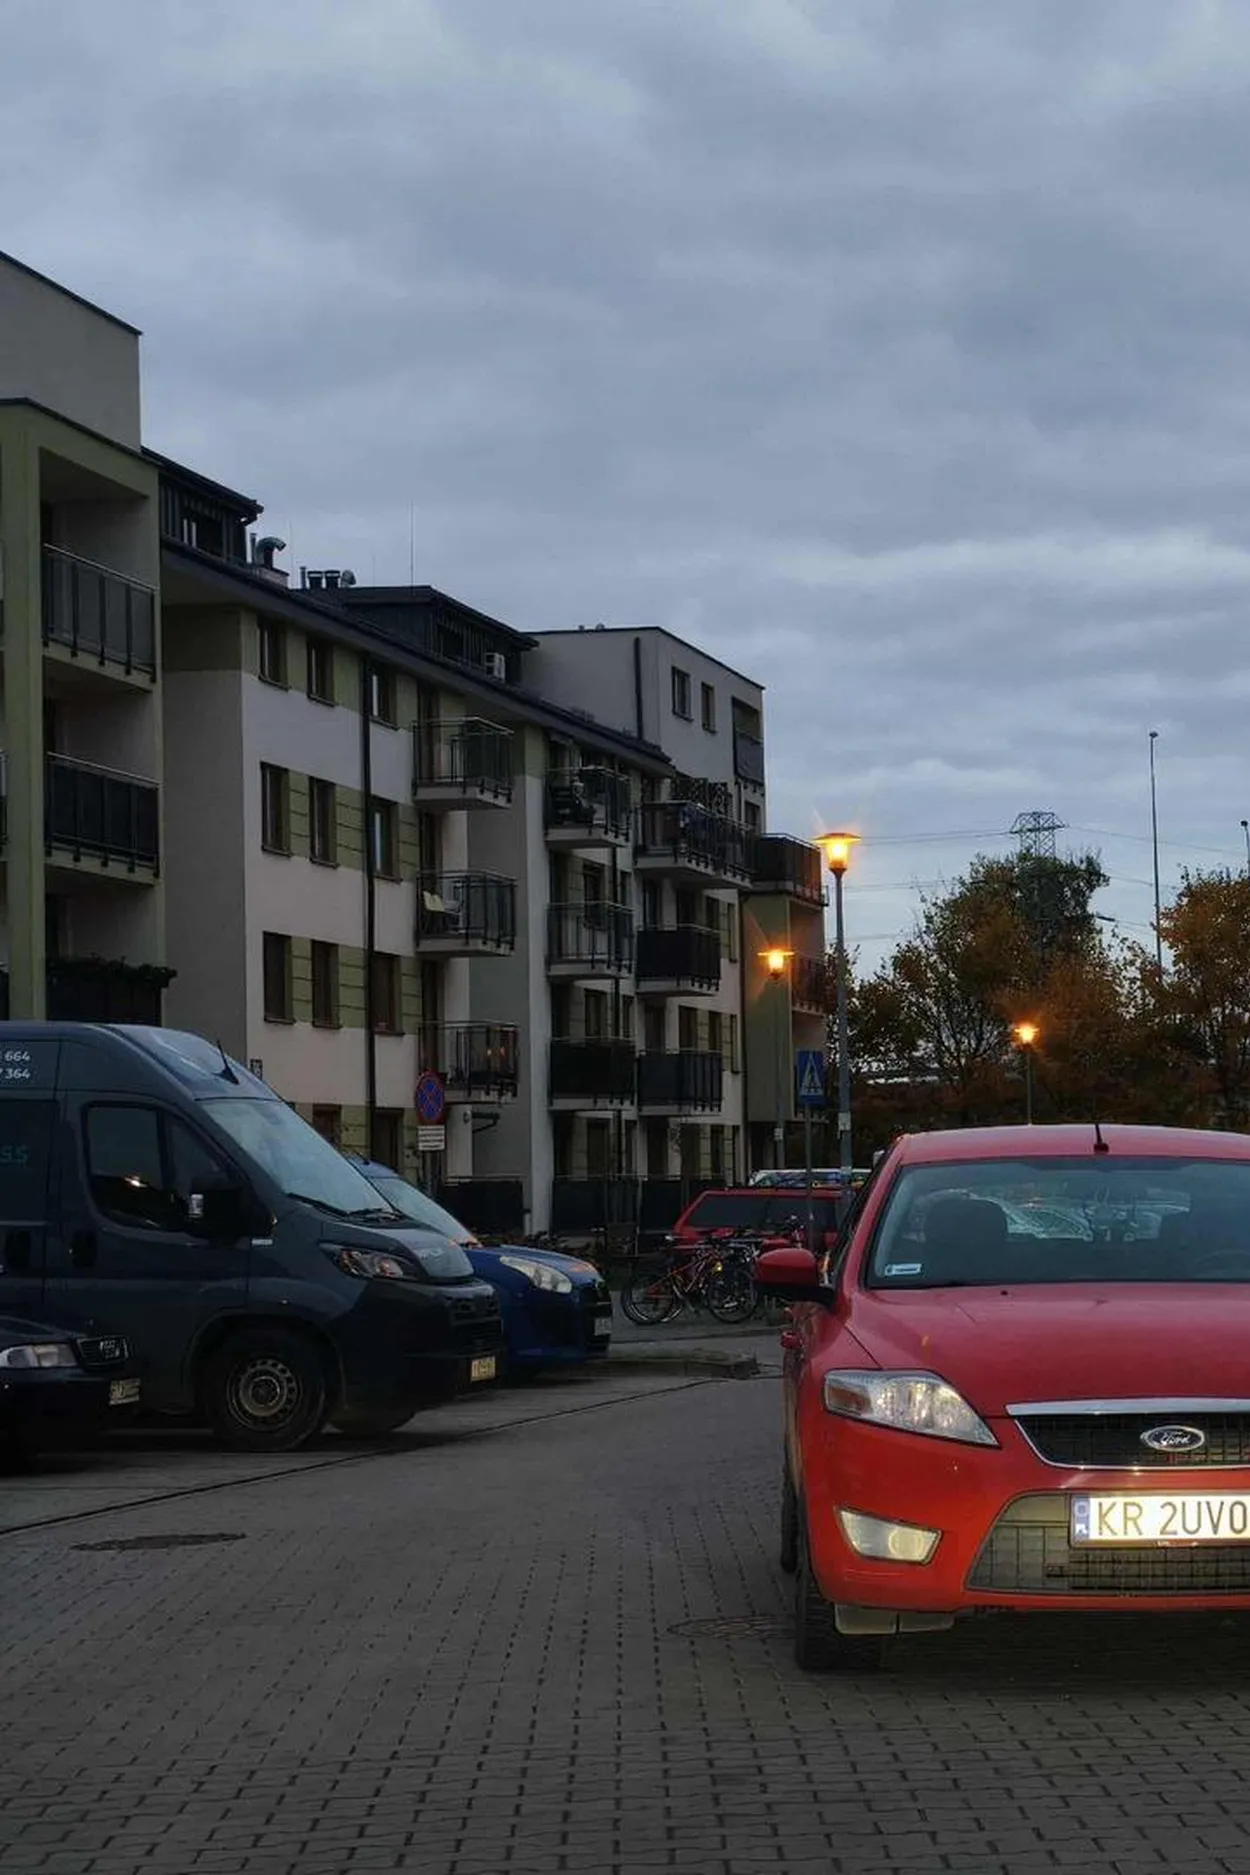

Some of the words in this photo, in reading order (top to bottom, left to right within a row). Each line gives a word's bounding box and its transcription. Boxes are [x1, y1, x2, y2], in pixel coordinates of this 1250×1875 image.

[4, 1050, 31, 1062] 664
[4, 1067, 31, 1079] 364
[1097, 1501, 1144, 1536] KR
